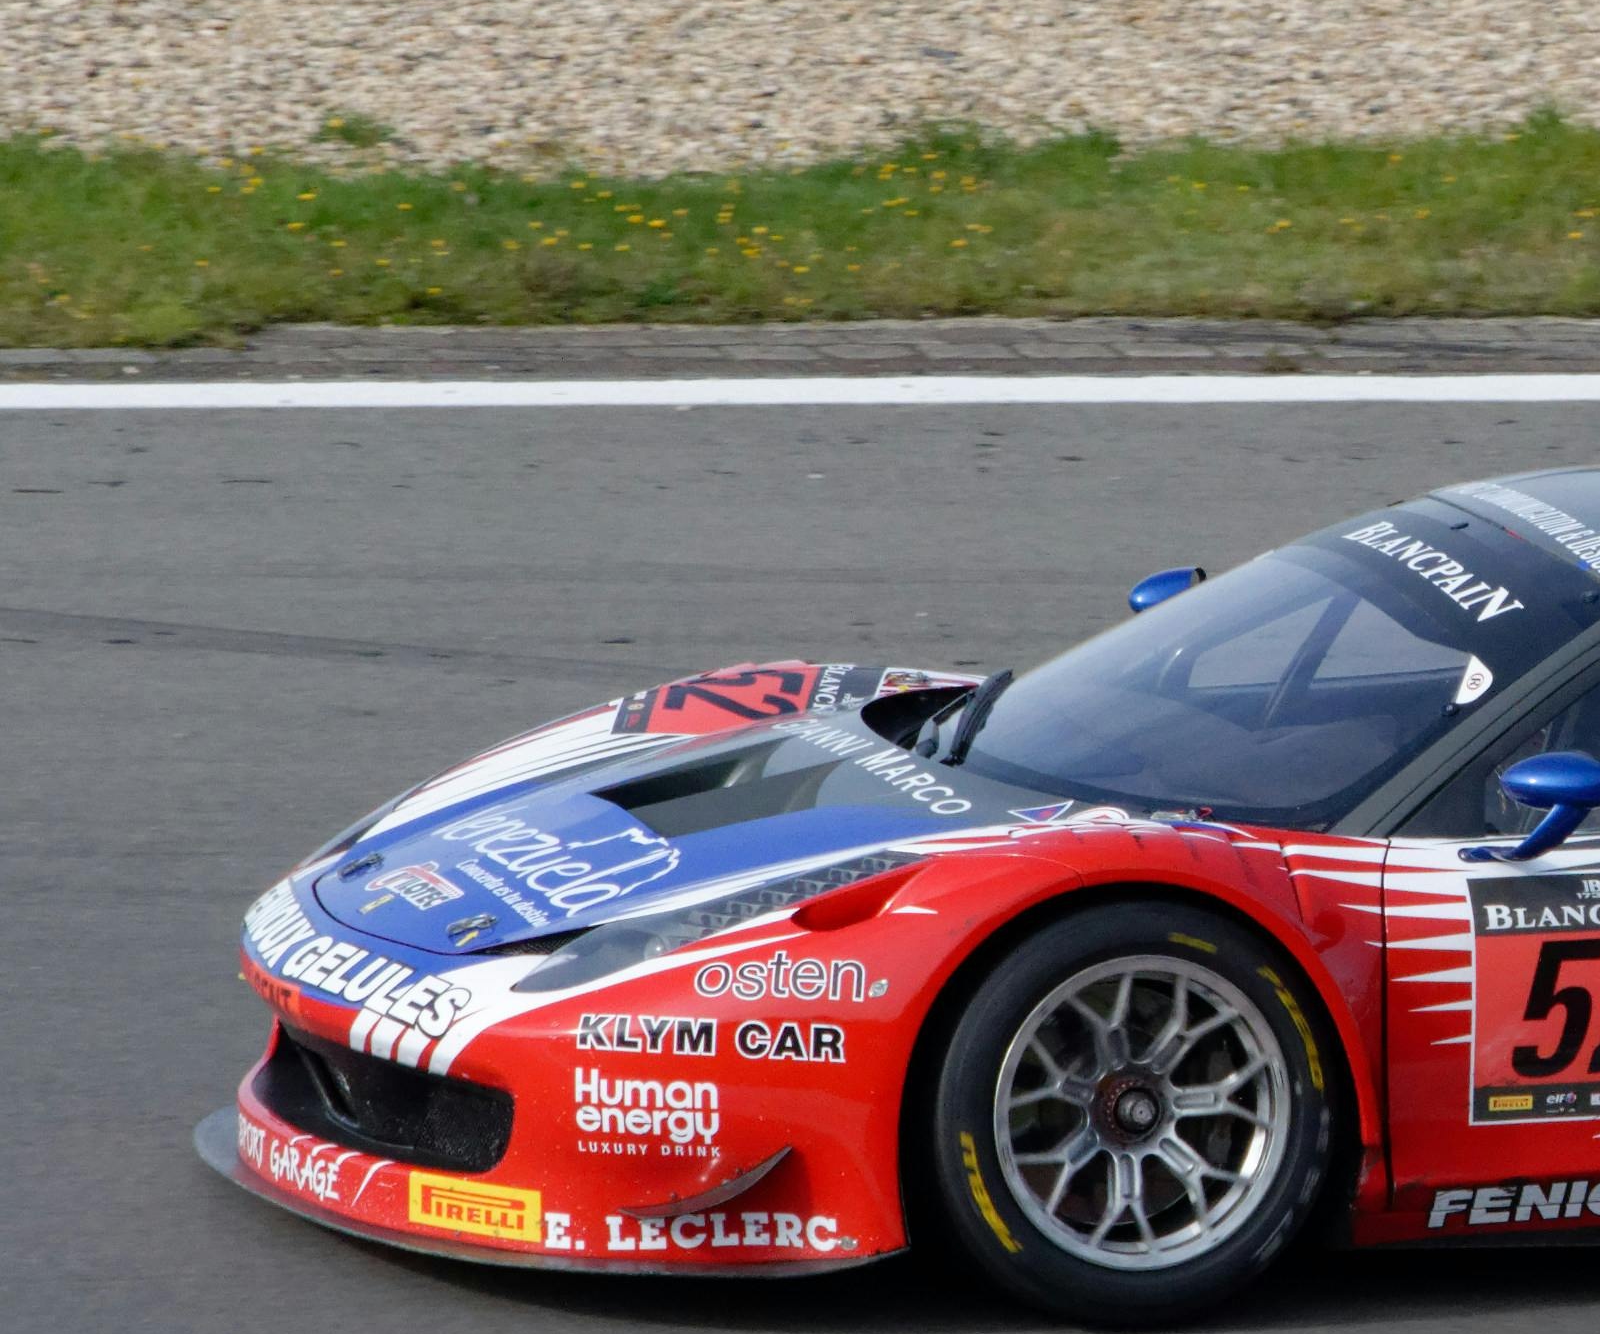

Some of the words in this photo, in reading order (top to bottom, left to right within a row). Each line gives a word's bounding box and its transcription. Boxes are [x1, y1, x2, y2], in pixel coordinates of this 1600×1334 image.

[1341, 521, 1525, 622] BLANCPAIN
[771, 718, 866, 756] GIANNI
[855, 748, 972, 816] MARCO
[281, 936, 472, 1038] GELULES
[694, 951, 865, 1001] osten
[576, 1014, 717, 1056] KLYM
[736, 1020, 846, 1063] CAR
[575, 1067, 719, 1110] Human
[576, 1105, 720, 1145] energy
[577, 1141, 649, 1155] LUXURY
[661, 1145, 721, 1157] DRINK
[270, 1138, 340, 1202] GARAGE
[421, 1185, 525, 1230] PIRELLI
[544, 1213, 584, 1250] E.
[606, 1212, 837, 1252] LECLERC
